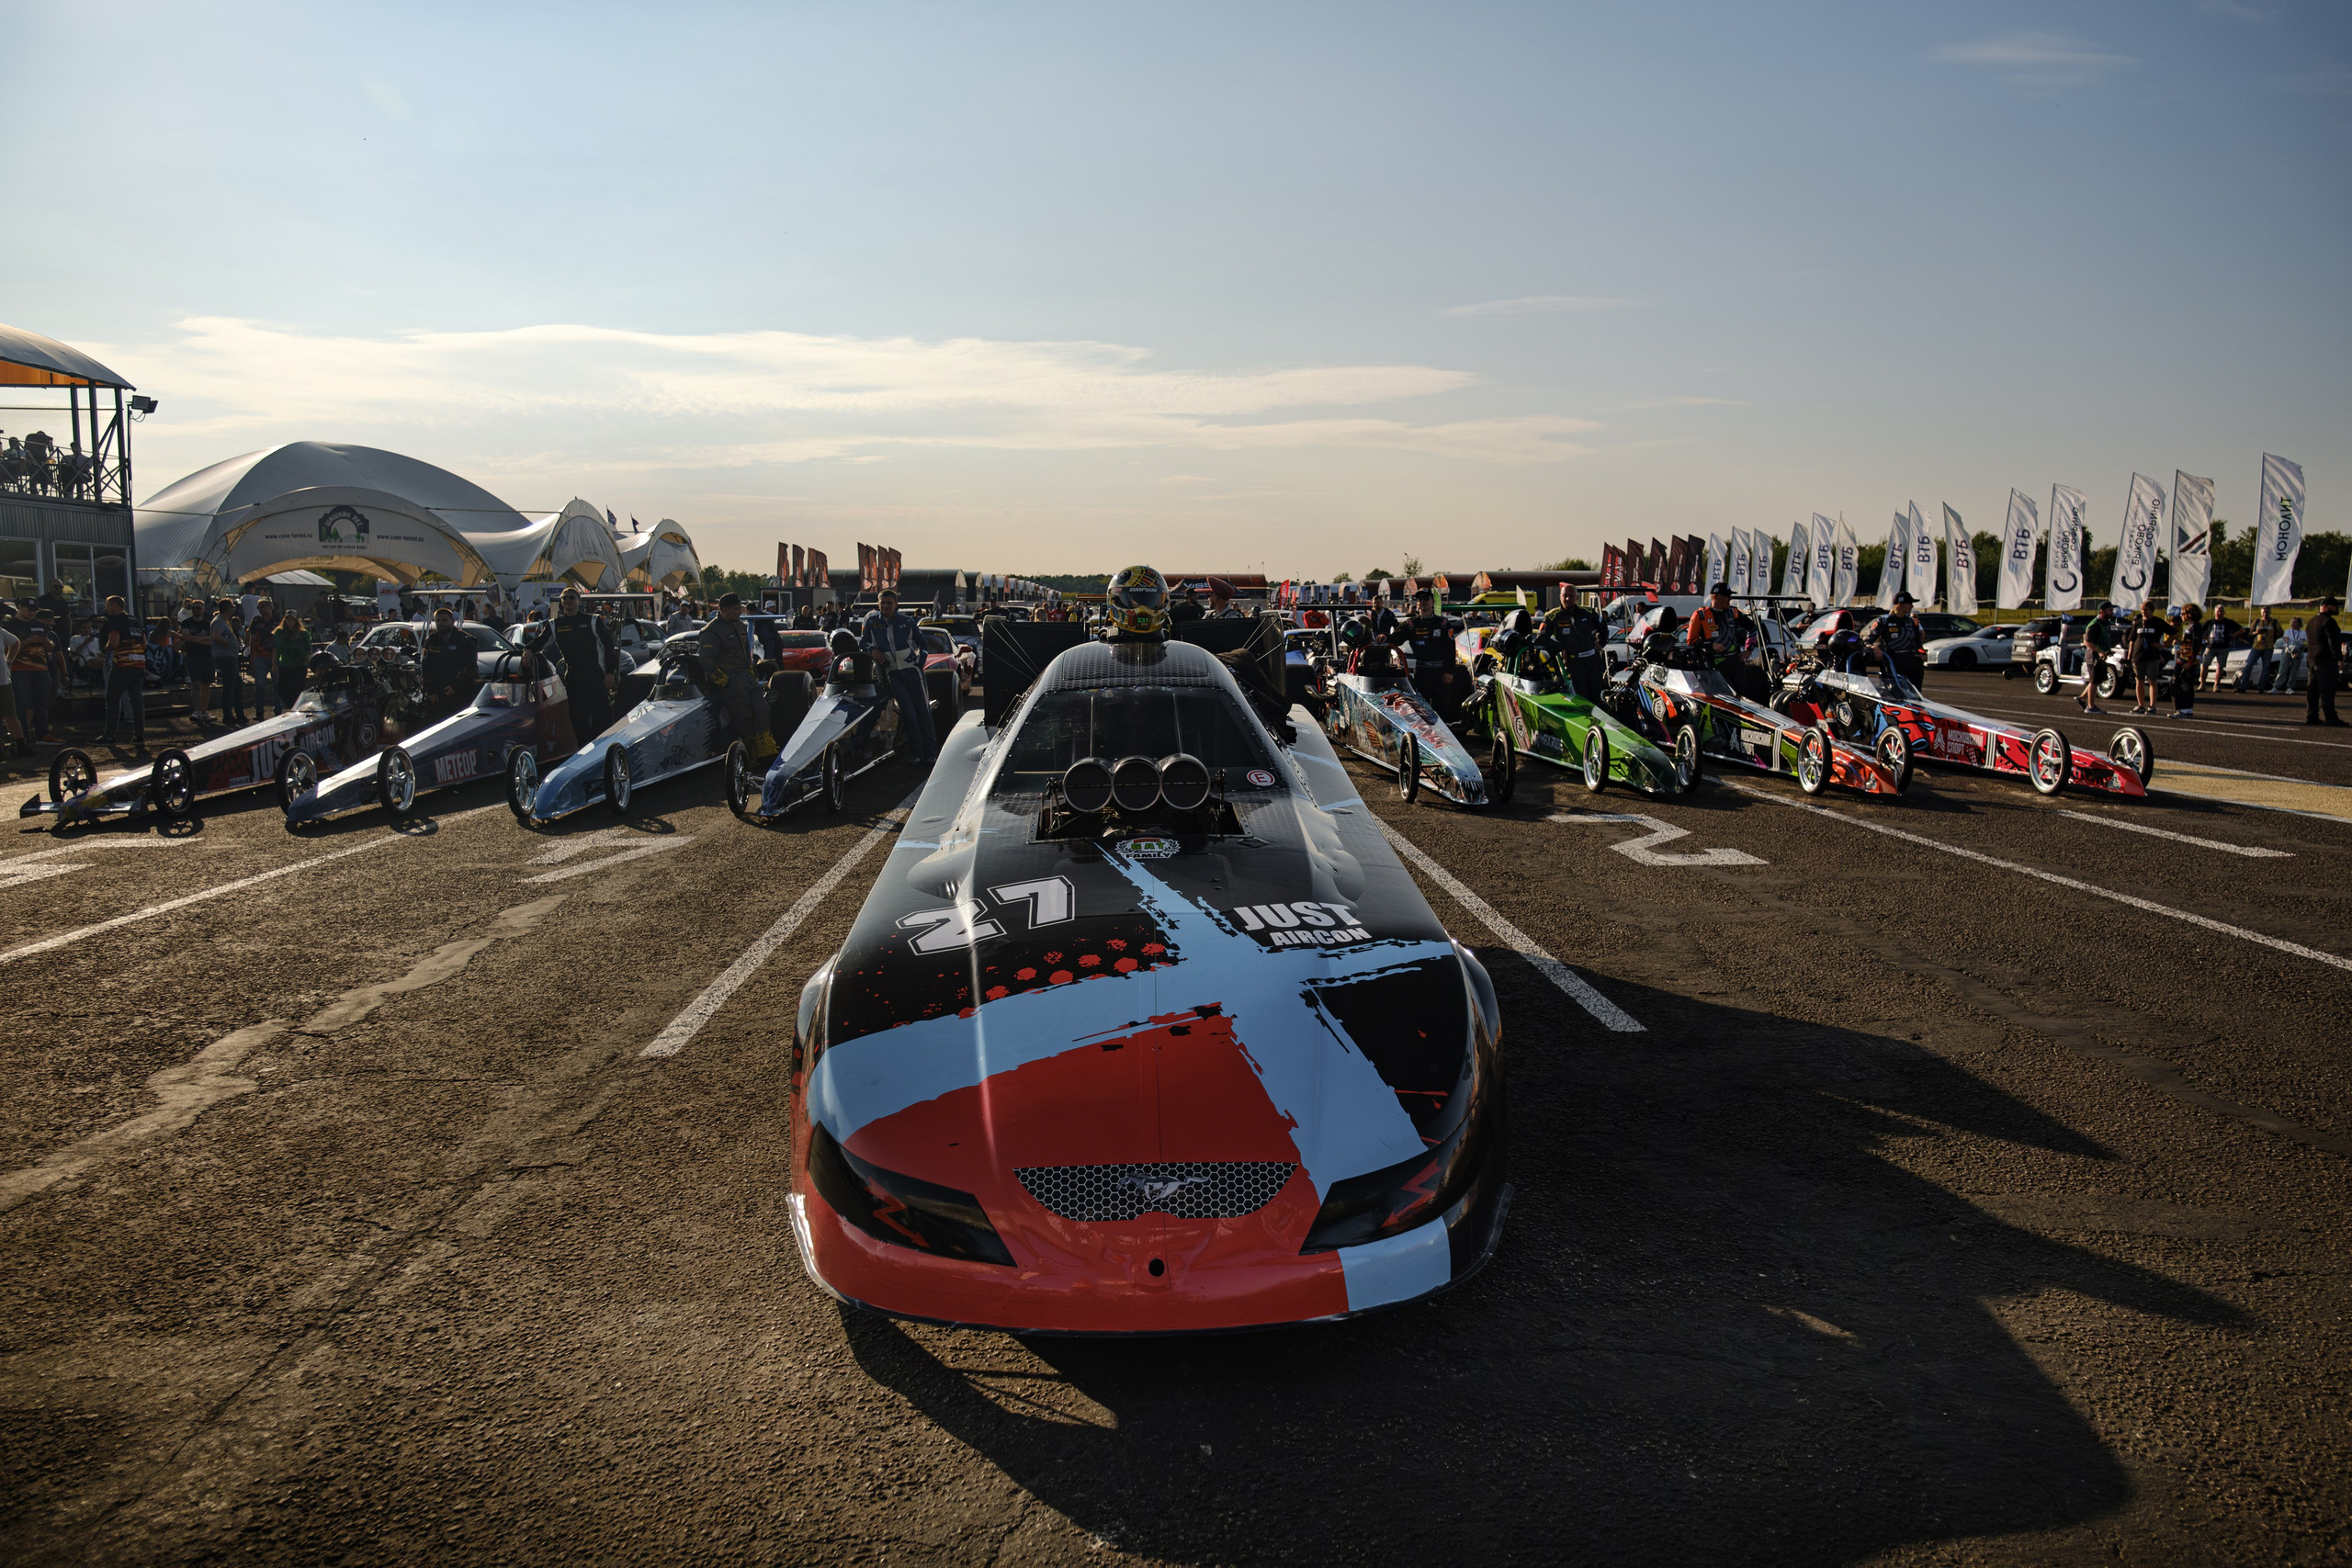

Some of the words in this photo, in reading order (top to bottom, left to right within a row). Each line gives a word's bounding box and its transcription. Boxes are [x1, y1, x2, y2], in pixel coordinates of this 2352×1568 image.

[324, 511, 351, 527] ШИШКИН
[352, 512, 364, 527] ЛЕС
[2144, 499, 2160, 547] СОФЬИНО
[2276, 496, 2291, 560] МОНОЛИТ
[1889, 542, 1903, 569] ВТБ
[1917, 536, 1930, 562] ВТБ
[1956, 539, 1969, 569] ВТБ
[2013, 528, 2030, 559] ВТБ
[2061, 530, 2071, 569] БЫКОВО
[2132, 524, 2146, 565] БЫКОВО
[1713, 558, 1722, 580] ВТБ
[1736, 554, 1746, 575] ВТБ
[1758, 555, 1768, 578] ВТБ
[1791, 551, 1802, 573] ВТБ
[1817, 545, 1828, 569] ВТБ
[1842, 547, 1853, 570] ВТБ
[1128, 584, 1159, 593] SIMPSON
[895, 875, 1075, 955] 27
[1232, 901, 1363, 931] JUST
[1269, 927, 1373, 946] AIRCON
